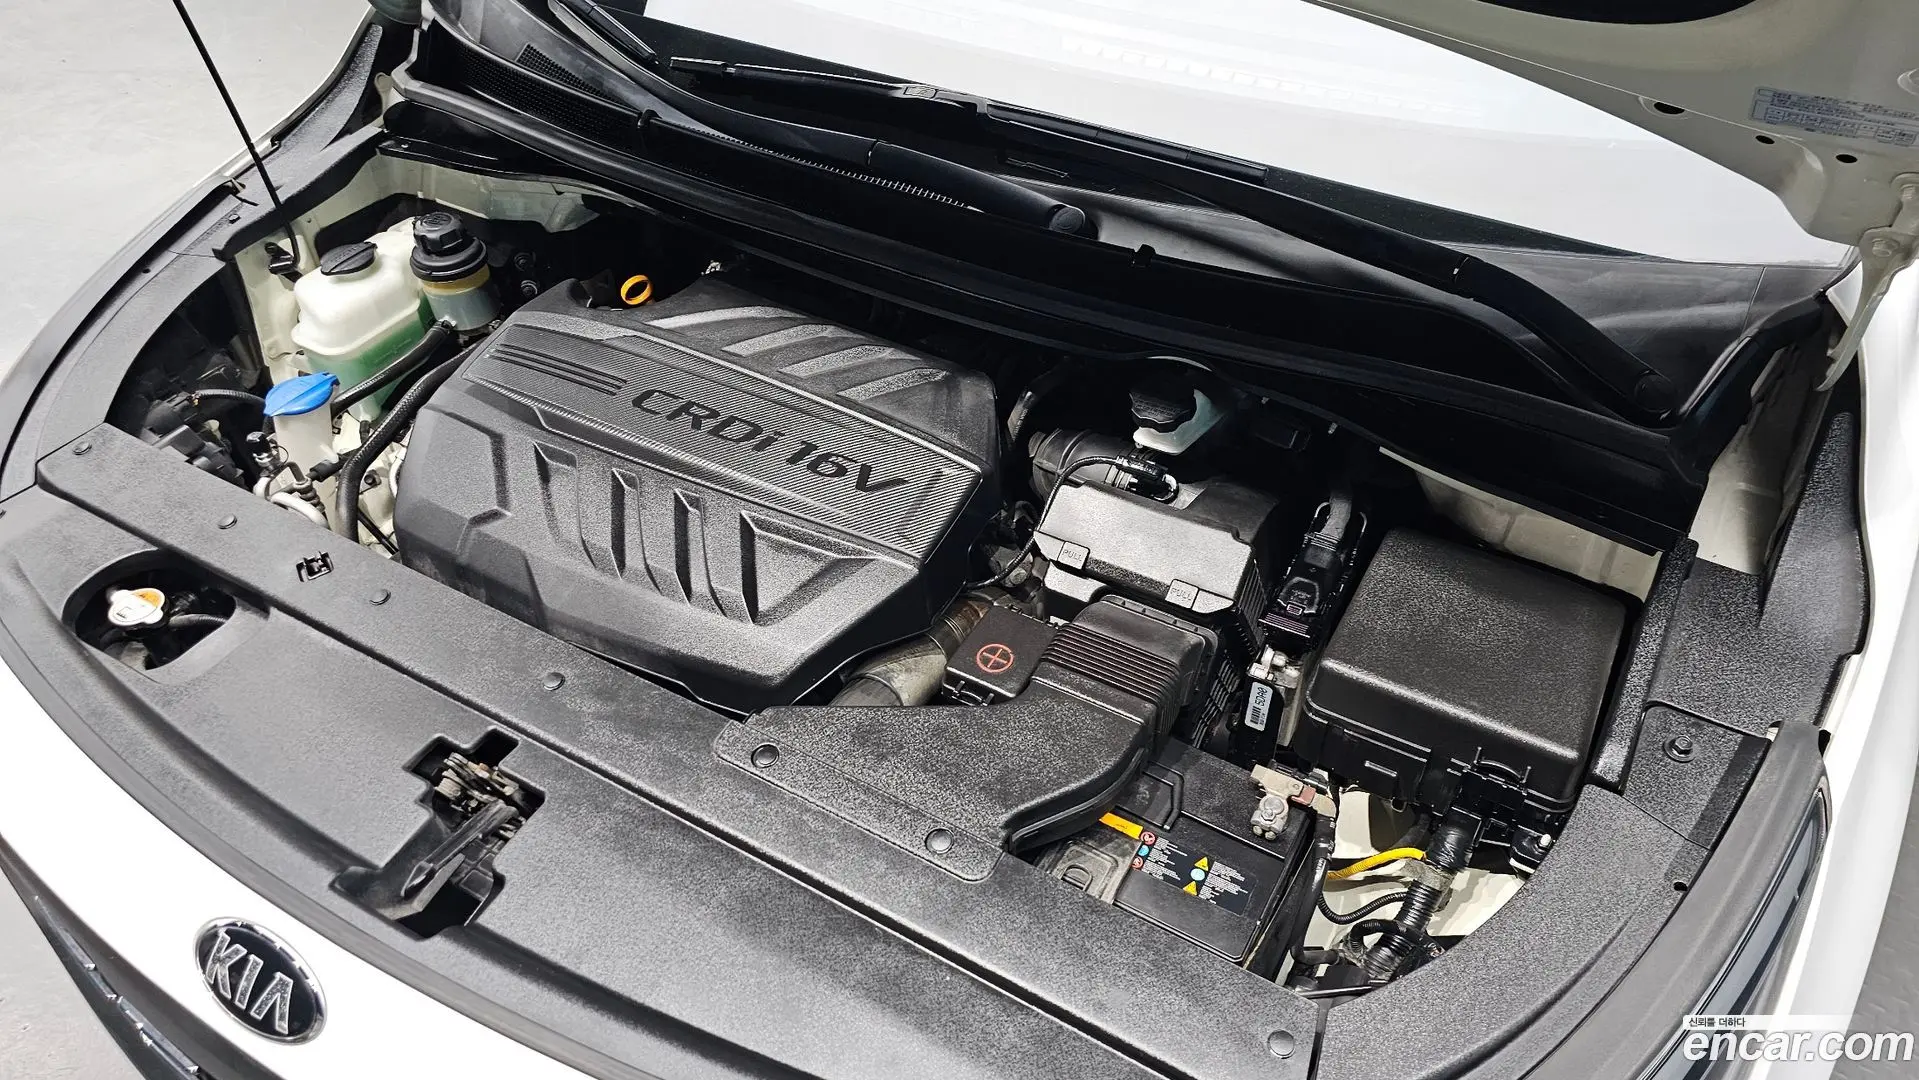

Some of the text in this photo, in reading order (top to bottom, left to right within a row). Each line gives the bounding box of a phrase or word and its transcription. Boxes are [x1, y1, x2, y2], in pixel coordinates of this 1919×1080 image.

[632, 388, 909, 494] CRDi 16V
[1062, 549, 1083, 562] PULL
[1170, 587, 1192, 601] PULL
[205, 928, 294, 1035] KIA
